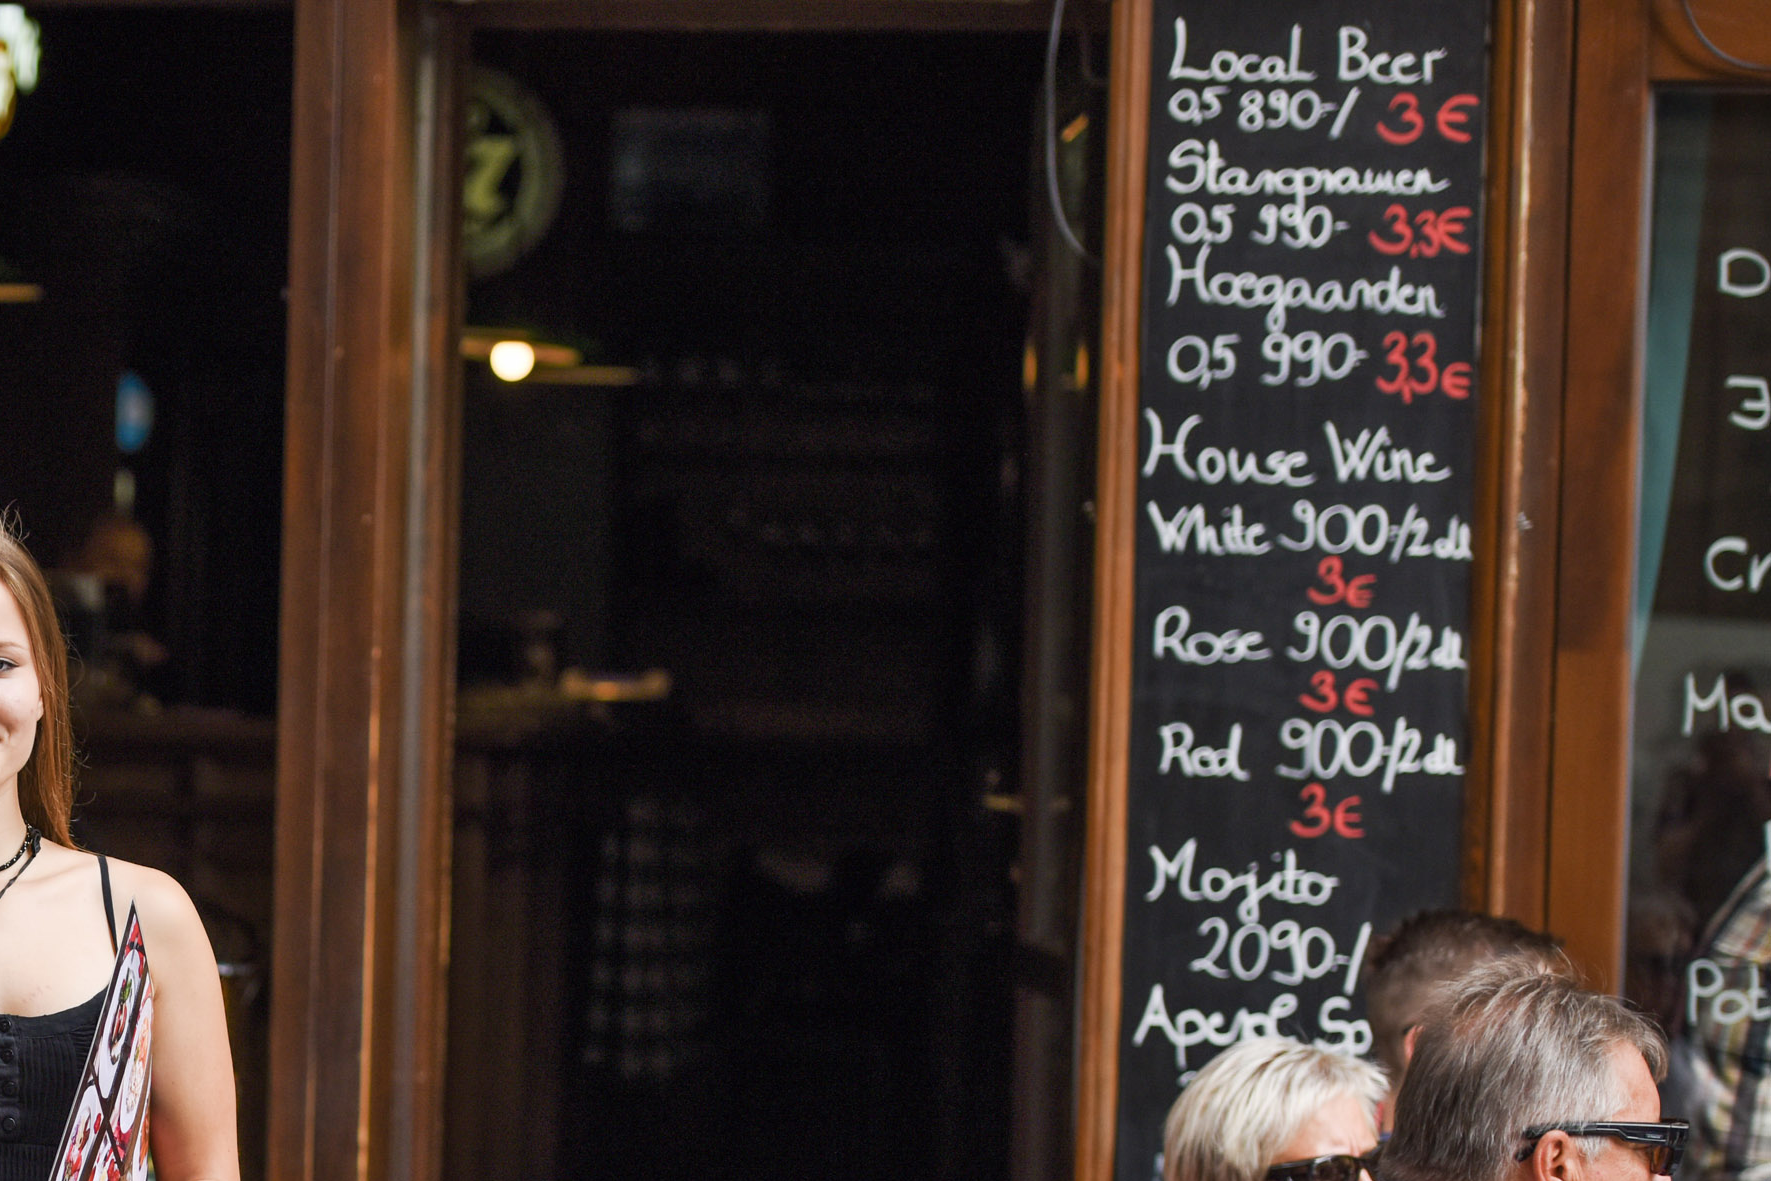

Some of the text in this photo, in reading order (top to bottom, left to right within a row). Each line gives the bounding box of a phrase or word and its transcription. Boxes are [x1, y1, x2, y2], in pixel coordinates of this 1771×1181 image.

[1338, 25, 1448, 85] Beer
[1368, 203, 1474, 258] 3,3€
[1375, 329, 1473, 404] 3,3€
[1143, 406, 1453, 487] House Wine
[1146, 499, 1273, 555] White
[1306, 554, 1378, 608] 3€
[1153, 604, 1272, 665] Rose
[1681, 671, 1771, 738] Ma
[1158, 720, 1251, 782] Red
[1288, 782, 1366, 838] 3€
[1145, 836, 1340, 925] Mojito
